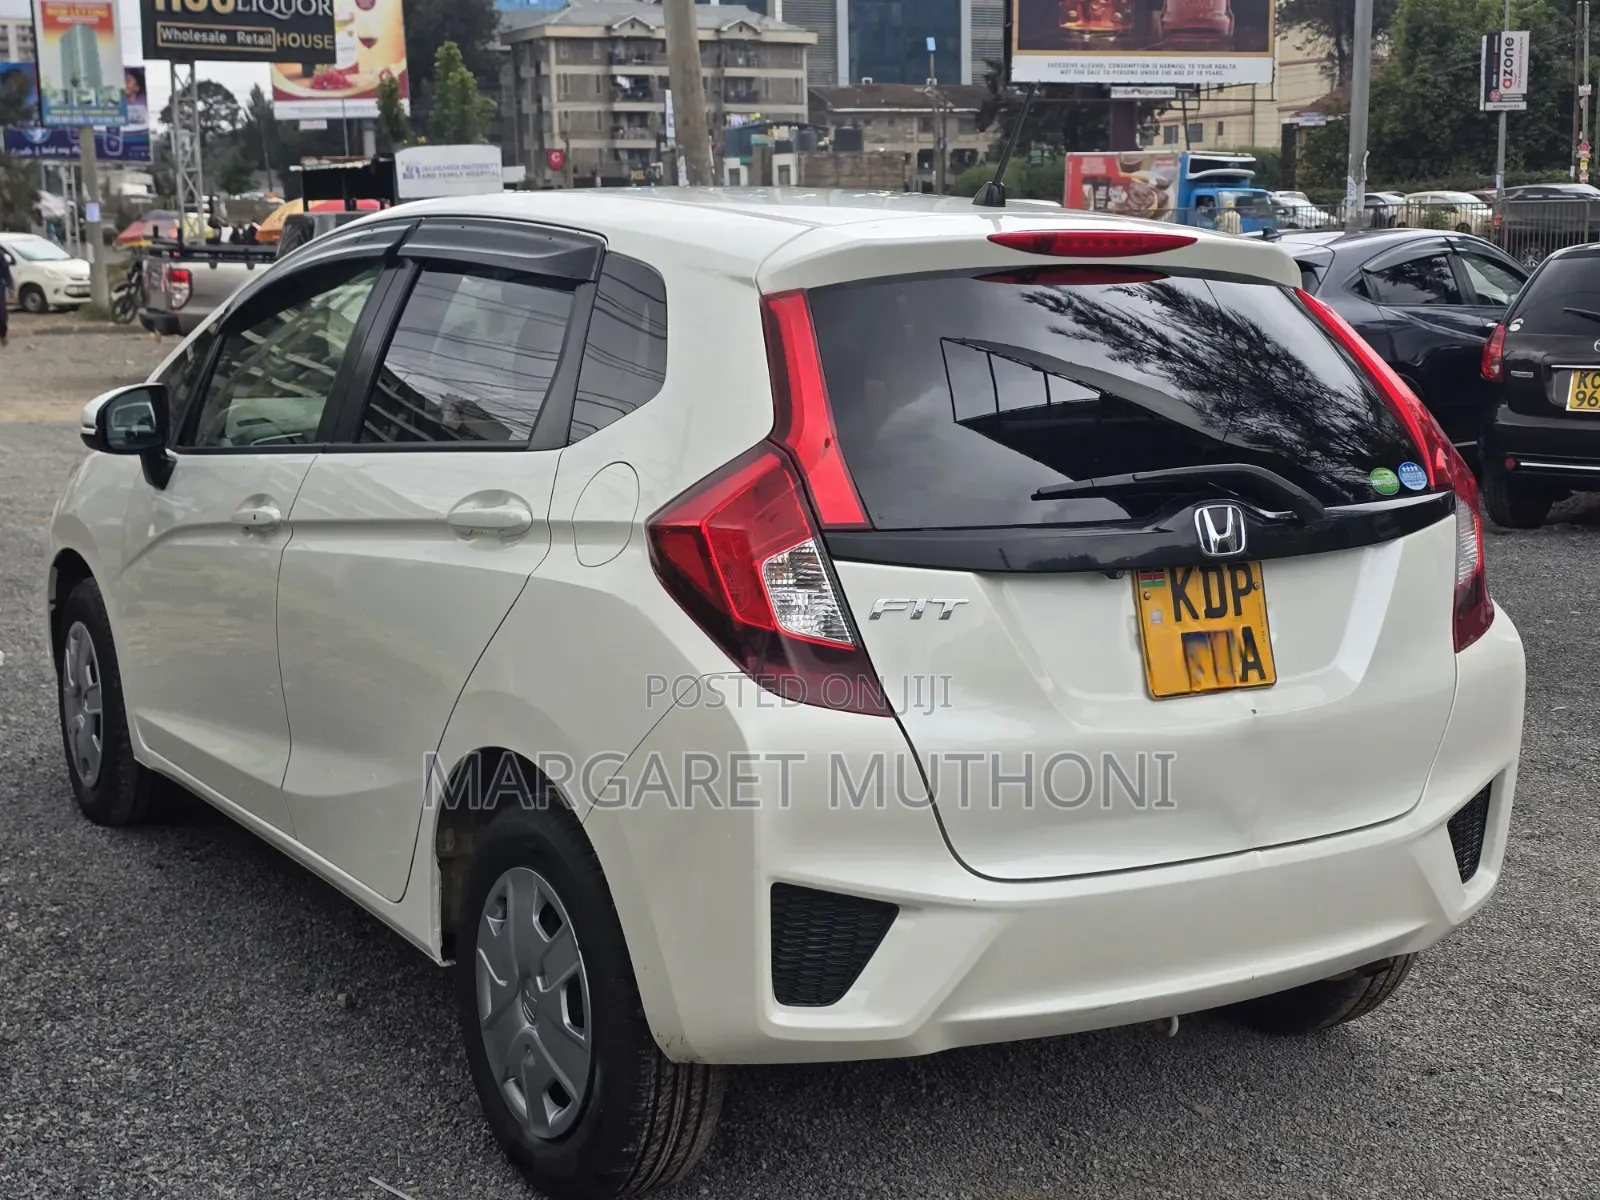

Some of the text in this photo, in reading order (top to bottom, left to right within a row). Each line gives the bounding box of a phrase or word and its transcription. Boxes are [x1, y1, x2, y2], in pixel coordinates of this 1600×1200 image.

[161, 27, 273, 46] Wholesale Retail
[276, 32, 334, 49] HOUSE
[1080, 62, 1106, 70] ALCOHOL
[1503, 36, 1514, 89] azone
[465, 169, 500, 177] HOSPITAL
[1169, 563, 1253, 622] KDP
[869, 598, 970, 620] FIT
